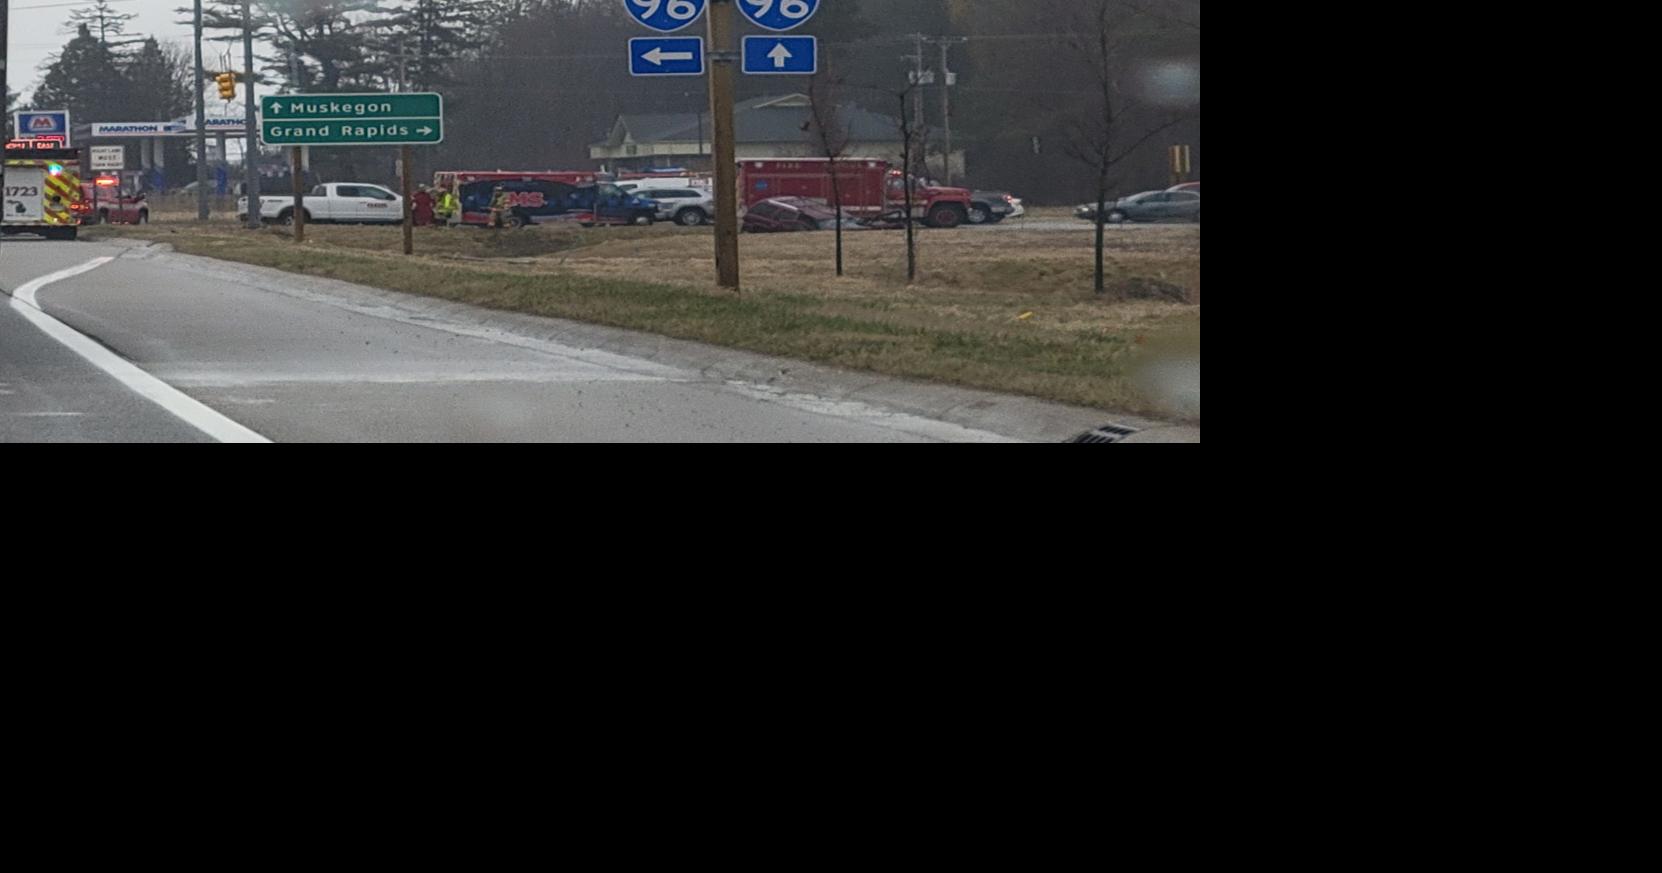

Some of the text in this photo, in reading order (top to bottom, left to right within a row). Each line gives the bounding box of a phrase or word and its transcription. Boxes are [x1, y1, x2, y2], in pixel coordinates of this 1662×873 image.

[291, 102, 392, 115] Muskegon
[270, 124, 409, 138] Grand Rapids
[6, 186, 38, 197] 1723
[508, 191, 544, 208] MS
